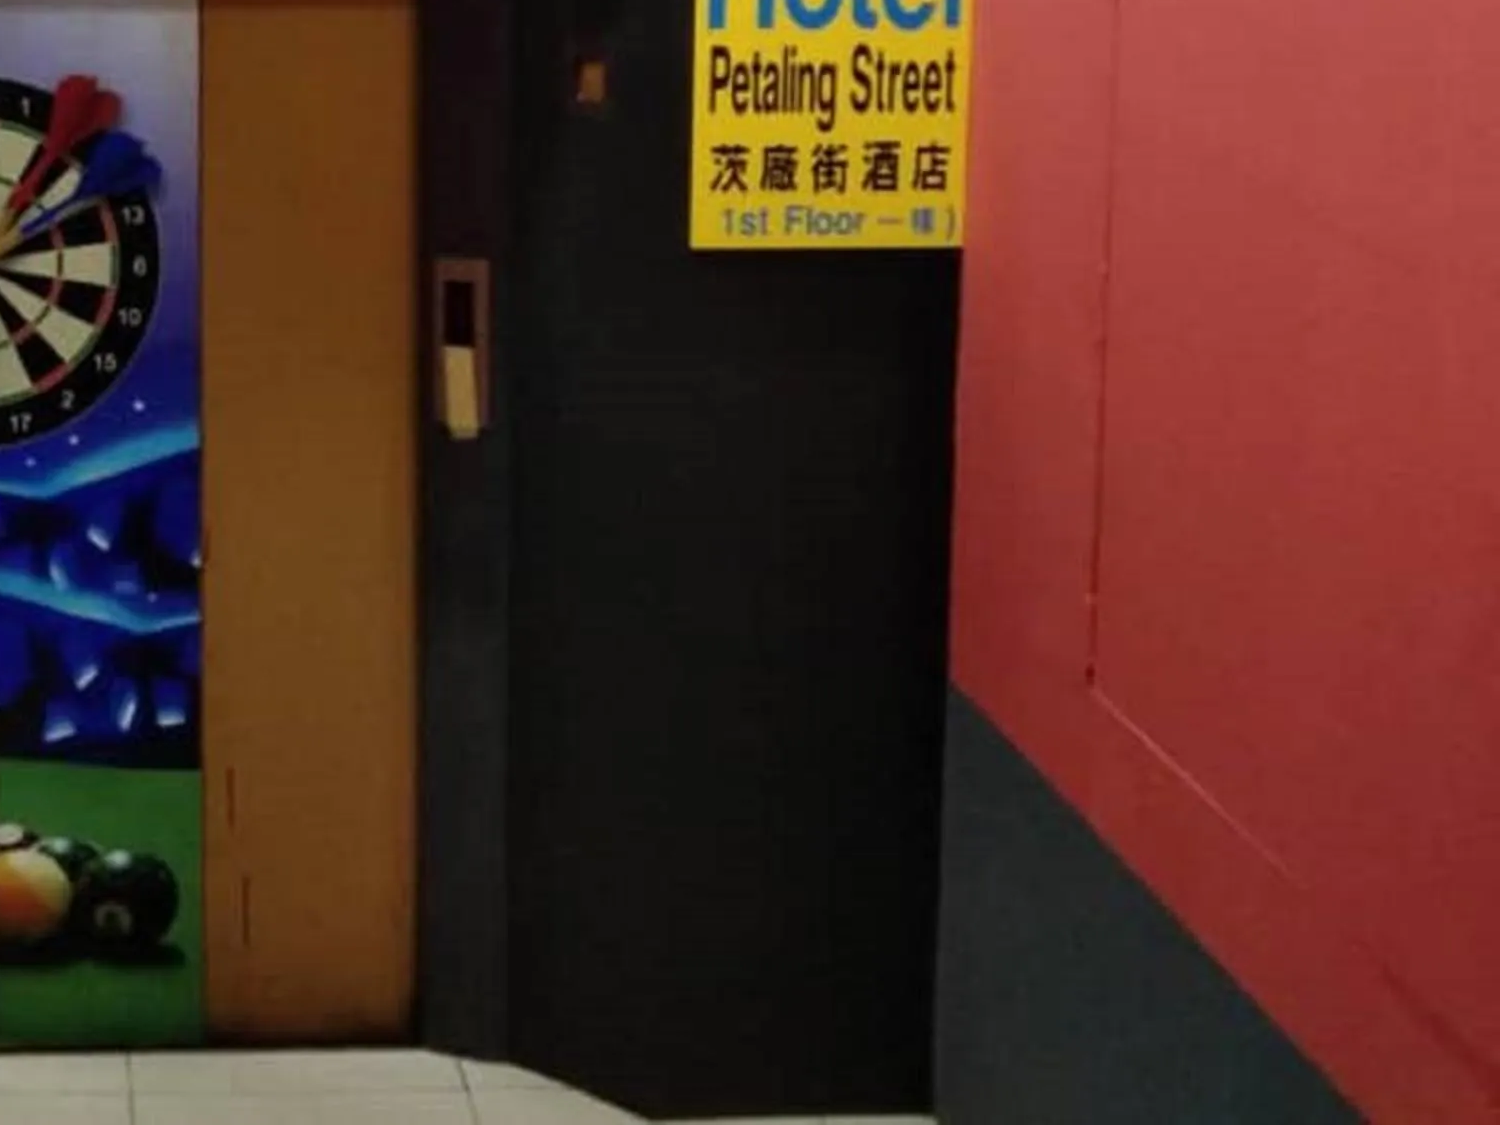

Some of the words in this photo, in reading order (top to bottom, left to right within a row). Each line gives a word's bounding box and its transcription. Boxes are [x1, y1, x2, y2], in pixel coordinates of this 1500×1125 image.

[708, 44, 838, 133] Petaling
[849, 43, 957, 115] Street
[709, 139, 953, 195] 茨廠街酒店
[722, 207, 771, 238] 1st
[783, 203, 867, 237] Floor
[118, 308, 142, 326] 10
[94, 353, 117, 372] 15
[9, 414, 32, 433] 17
